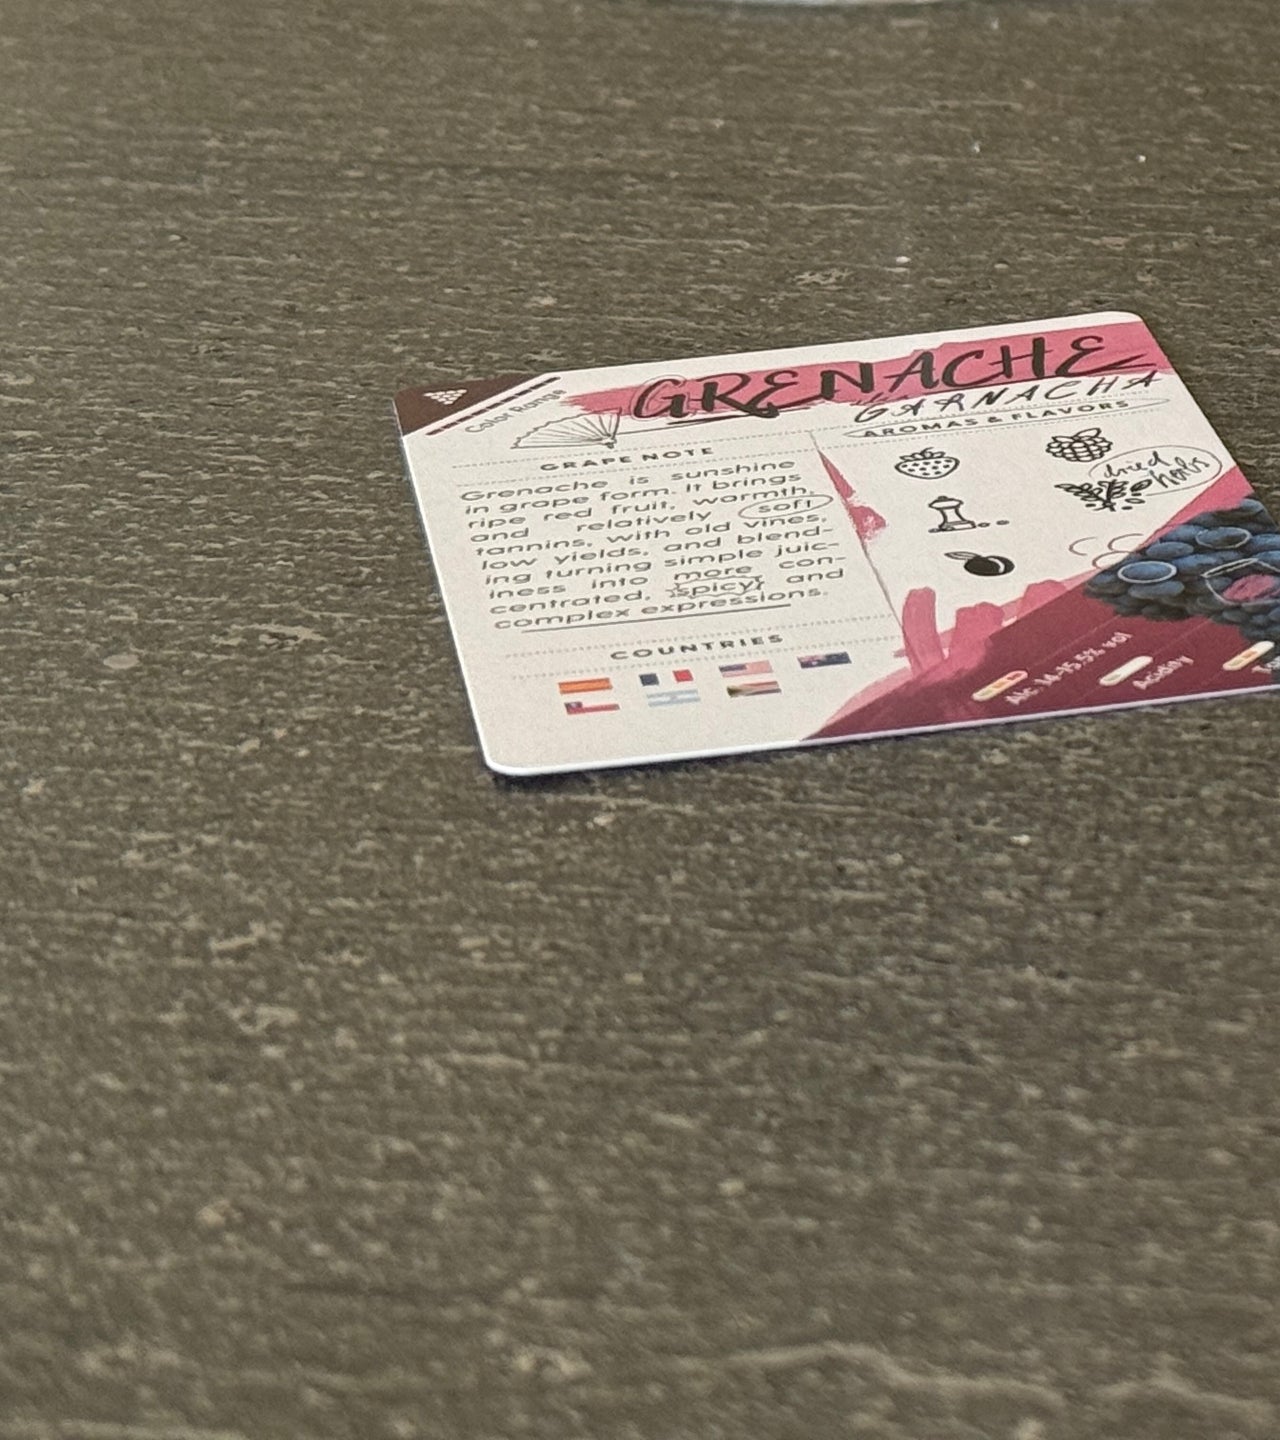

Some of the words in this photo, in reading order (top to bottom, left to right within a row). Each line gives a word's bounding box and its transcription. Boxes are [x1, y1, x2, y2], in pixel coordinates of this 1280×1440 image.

[634, 336, 1148, 420] GRENACHE
[854, 371, 1161, 423] GARNACHA
[465, 411, 510, 433] Color
[513, 389, 567, 412] Range
[864, 418, 978, 437] AROMAS
[987, 414, 1001, 423] &
[1012, 401, 1129, 420] FLAVORS
[540, 455, 631, 471] GRAPE
[642, 447, 714, 463] NOTE
[1103, 452, 1171, 480] dried
[461, 480, 608, 502] Grenache
[629, 476, 649, 484] is
[671, 459, 795, 481] sunshine
[466, 505, 489, 515] in
[500, 495, 588, 514] grape
[601, 488, 676, 501] form.
[686, 483, 700, 492] It
[713, 472, 801, 491] brings
[468, 514, 525, 529] ripe
[544, 508, 591, 521] red
[471, 528, 528, 542] and
[577, 510, 711, 532] relatively
[758, 498, 811, 514] soft
[607, 529, 669, 543] with
[685, 522, 730, 535] old
[482, 557, 536, 570] low
[664, 537, 721, 552] and
[738, 526, 833, 545] blend-
[485, 571, 531, 585] ing
[547, 561, 651, 581] turning
[665, 548, 762, 568] simple
[775, 541, 839, 558] juic-
[489, 584, 565, 599] iness
[592, 575, 648, 590] into
[674, 565, 752, 581] more
[779, 557, 846, 569] con-
[786, 568, 843, 583] and
[495, 607, 629, 629] complex
[641, 589, 828, 615] expressions.
[610, 635, 783, 660] COUNTRIES
